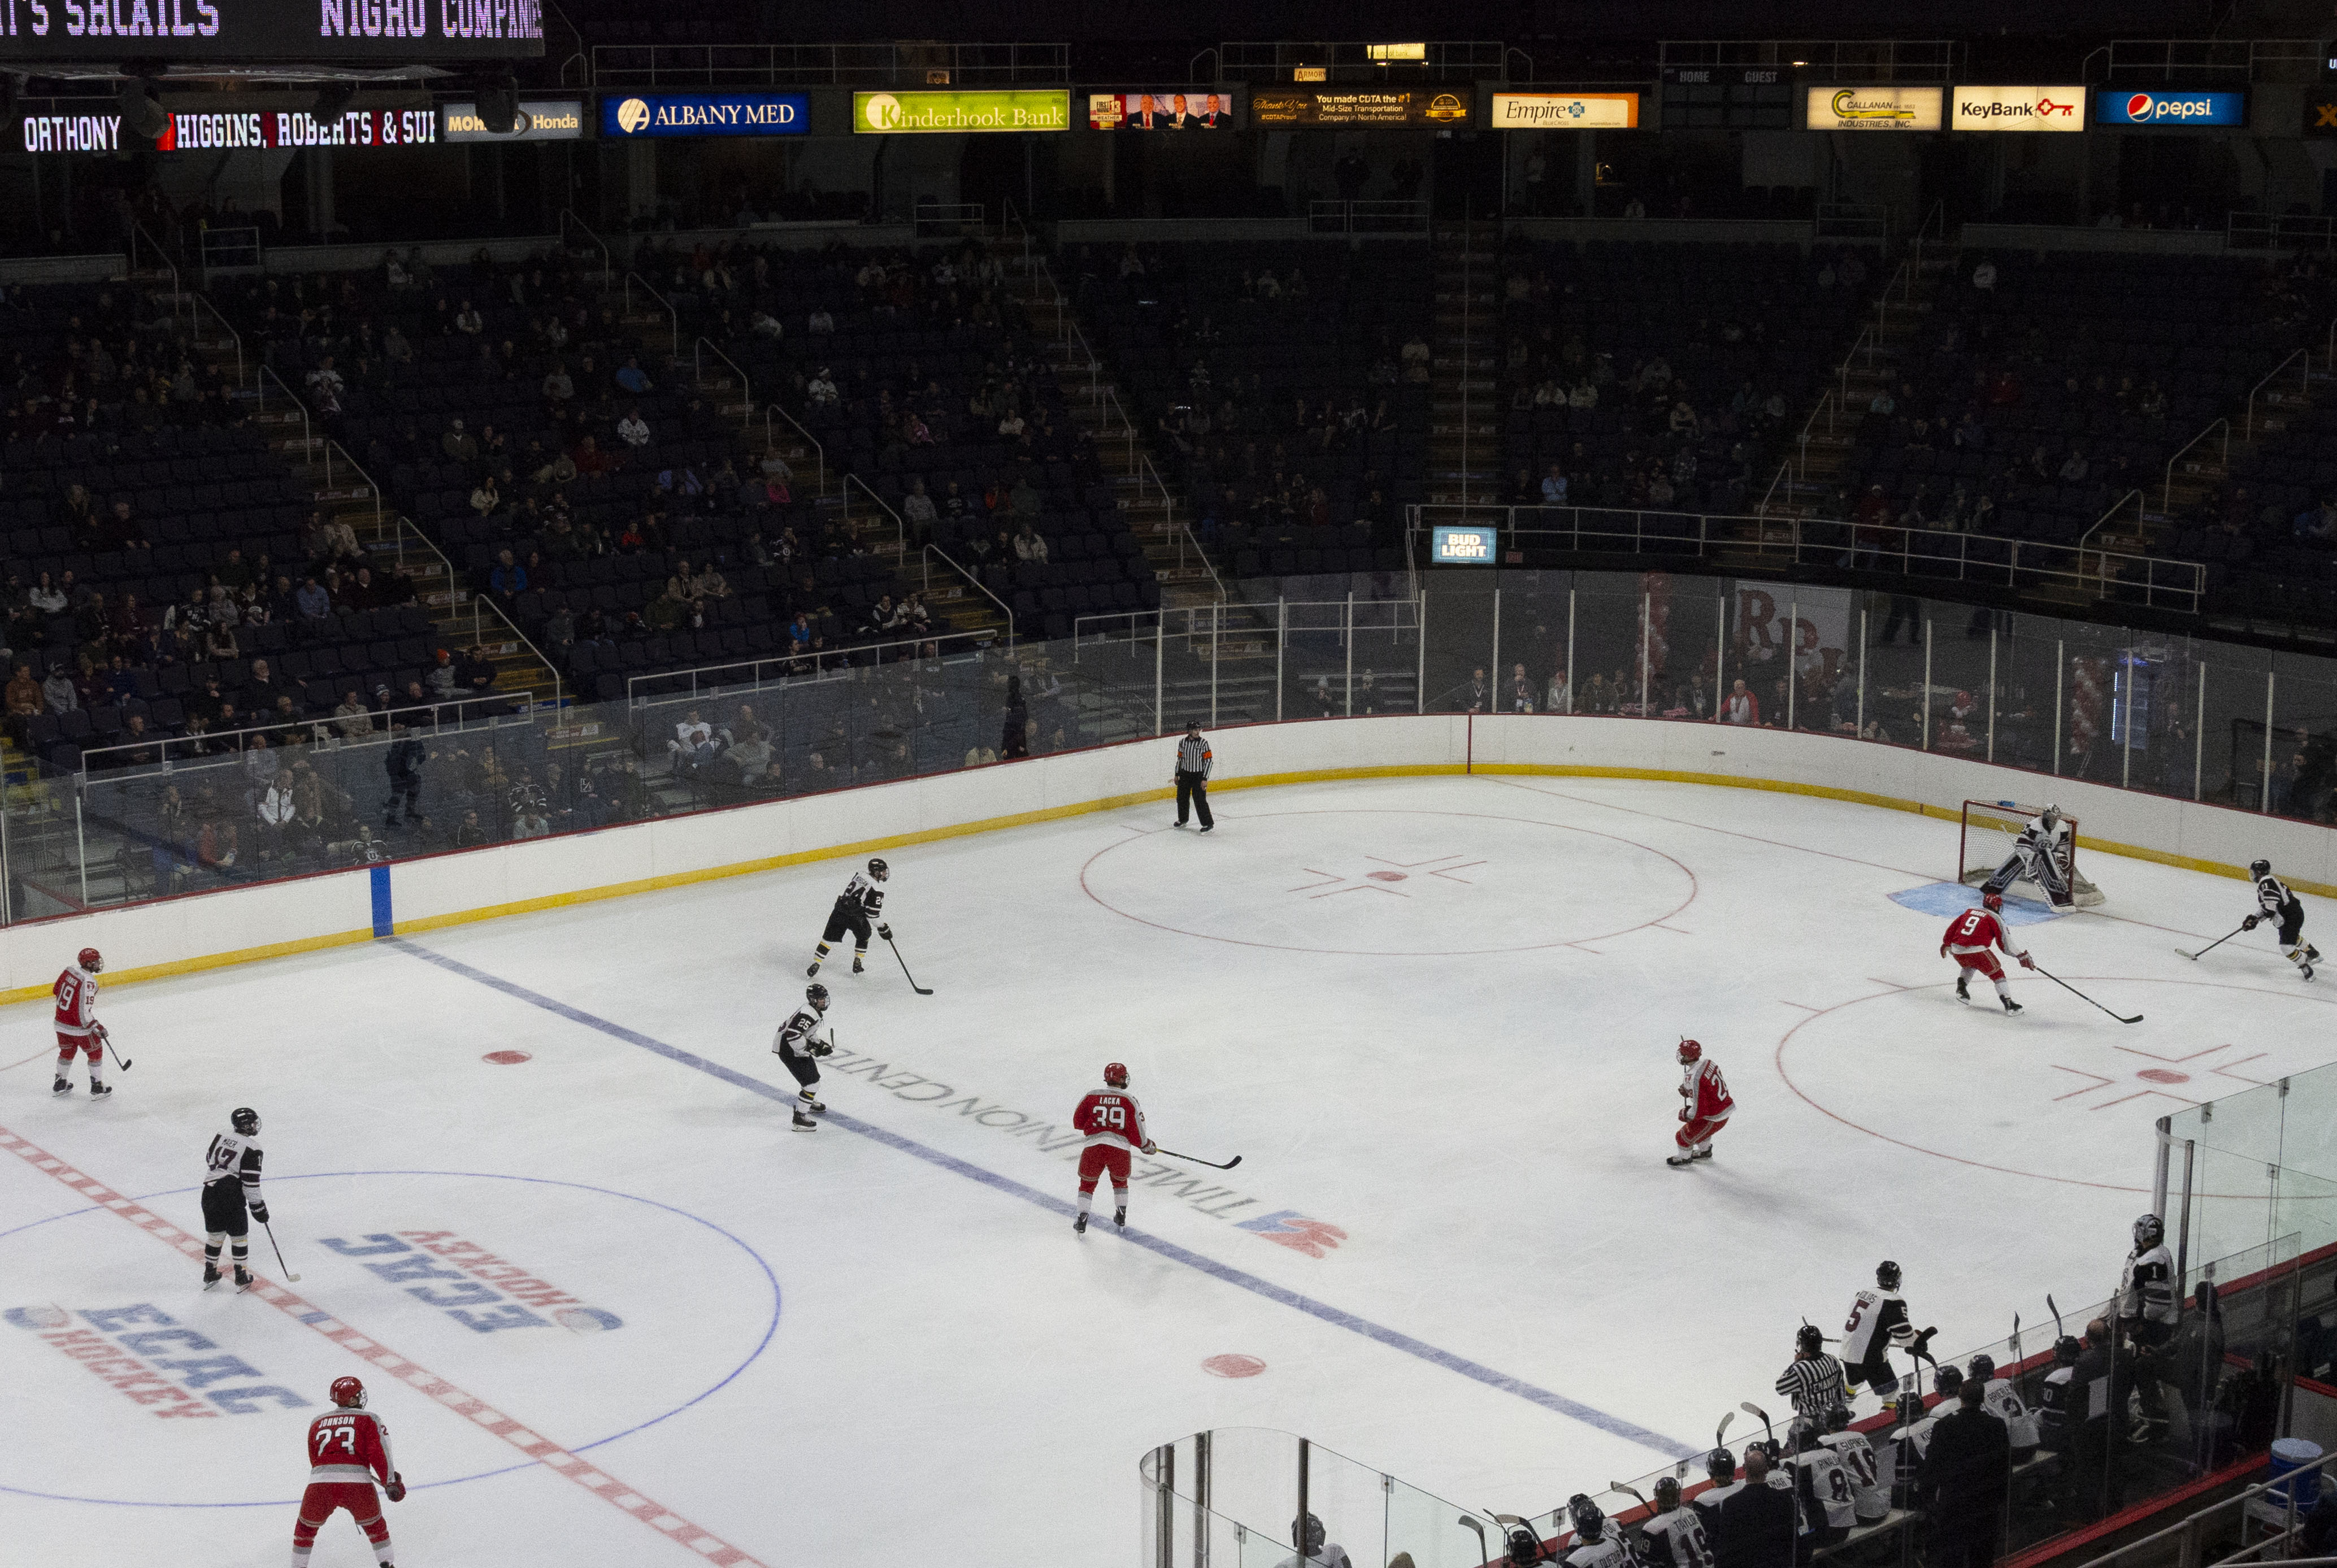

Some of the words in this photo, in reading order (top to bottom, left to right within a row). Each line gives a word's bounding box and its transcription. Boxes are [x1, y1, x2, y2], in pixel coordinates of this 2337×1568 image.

[1680, 71, 1709, 82] HOME
[1745, 71, 1777, 82] GUEST
[1334, 94, 1357, 103] made
[1383, 94, 1396, 103] the
[1398, 93, 1410, 103] #1
[1847, 101, 1893, 109] CALLANAN
[654, 105, 741, 125] ALBANY
[745, 104, 794, 124] MED
[881, 104, 1006, 128] Kinderhook
[1013, 106, 1063, 126] Bank
[1354, 105, 1403, 113] Transportation
[1506, 101, 1566, 123] Empire
[1961, 102, 2033, 119] KeyBank
[2156, 98, 2211, 119] pepsi
[533, 114, 578, 129] Honda
[1319, 114, 1349, 122] Company
[1895, 120, 1912, 128] INC.
[176, 114, 267, 149] HIGGINS,
[383, 111, 397, 144] &
[1448, 533, 1481, 546] BUD
[1441, 545, 1487, 557] LIGHT
[1961, 915, 1980, 936] 9
[57, 981, 75, 1011] 19
[85, 996, 94, 1005] 19
[797, 1018, 812, 1031] 25
[816, 1048, 955, 1101] CENTE
[1092, 1106, 1126, 1130] 39
[1139, 1111, 1145, 1122] 3
[209, 1146, 238, 1171] 17
[398, 1231, 584, 1308] HOCKEY
[318, 1233, 553, 1335] ECAC
[1845, 1298, 1870, 1333] 5
[76, 1302, 314, 1414] ECAC
[40, 1328, 221, 1419] HOCKEY
[318, 1416, 355, 1428] JOHNSON
[380, 1424, 389, 1436] 2
